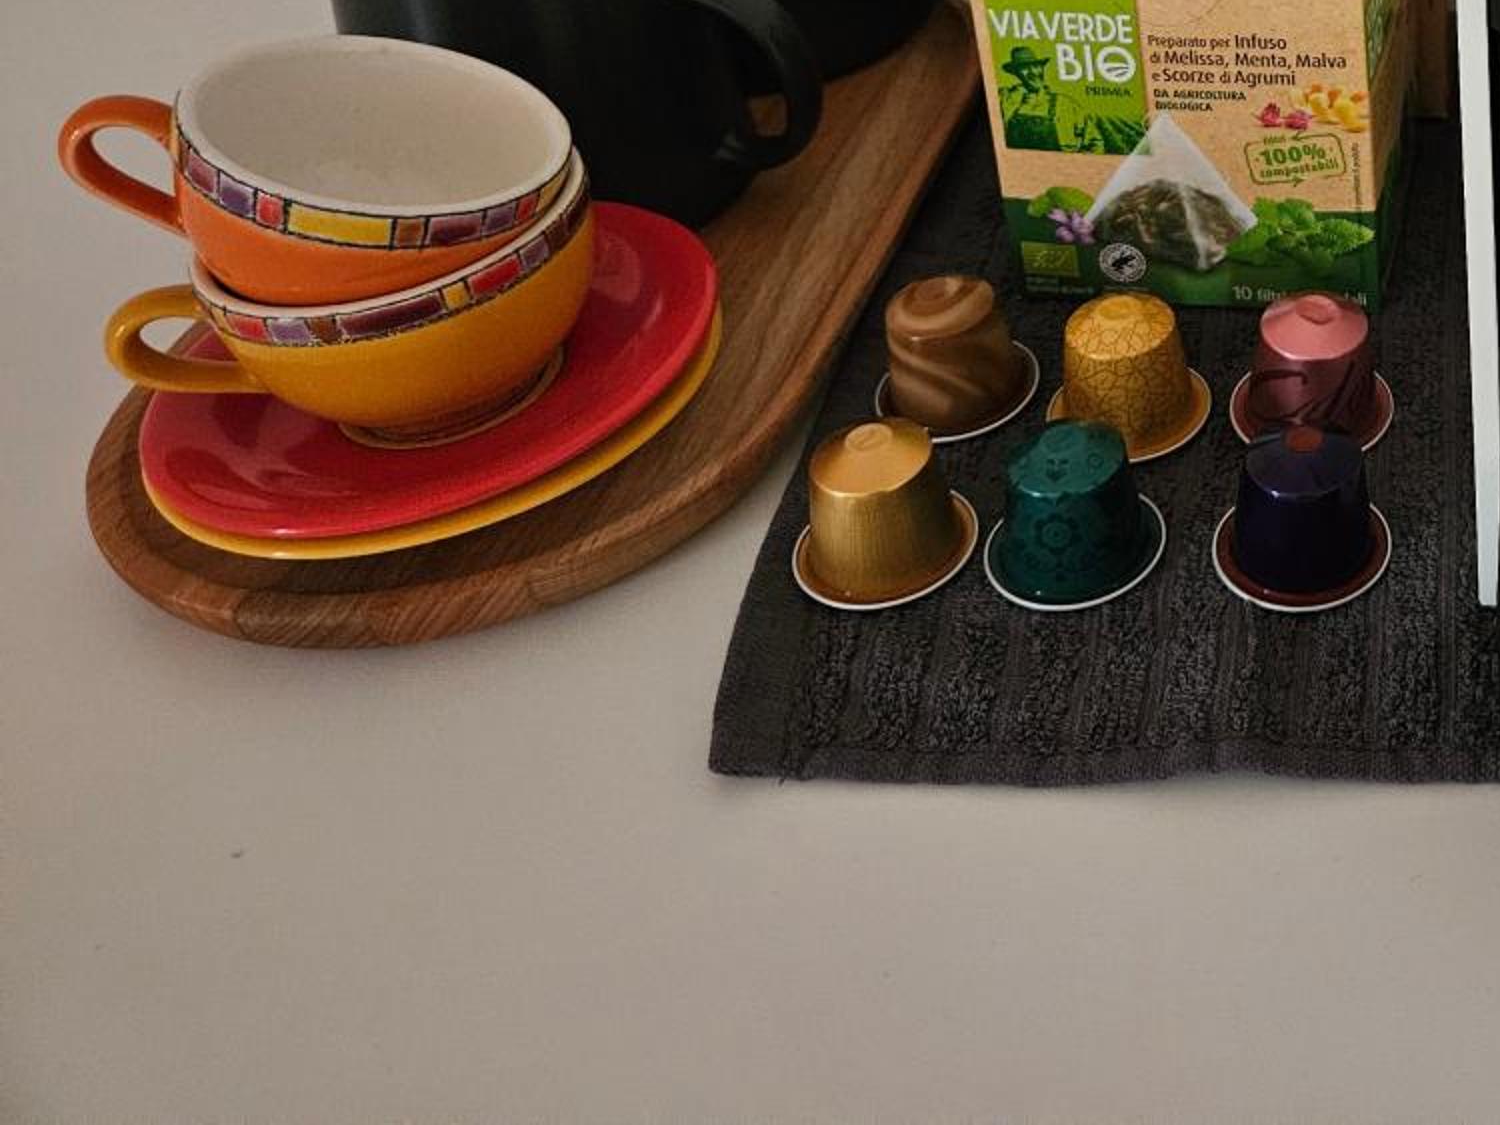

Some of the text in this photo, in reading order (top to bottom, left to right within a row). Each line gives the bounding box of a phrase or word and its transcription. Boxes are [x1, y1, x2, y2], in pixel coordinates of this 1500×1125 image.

[1147, 33, 1287, 51] Preparato per Infuso
[1055, 42, 1136, 84] BIO
[1150, 50, 1347, 70] di Melissa, Menta, Malva
[1151, 68, 1297, 88] e Scorze di Agrumi
[1153, 88, 1248, 101] DA AGRICOLTURA
[1155, 100, 1214, 112] BIOLOGICA
[1259, 143, 1327, 167] 100%
[1260, 156, 1340, 179] compostabili
[1232, 285, 1253, 300] 10
